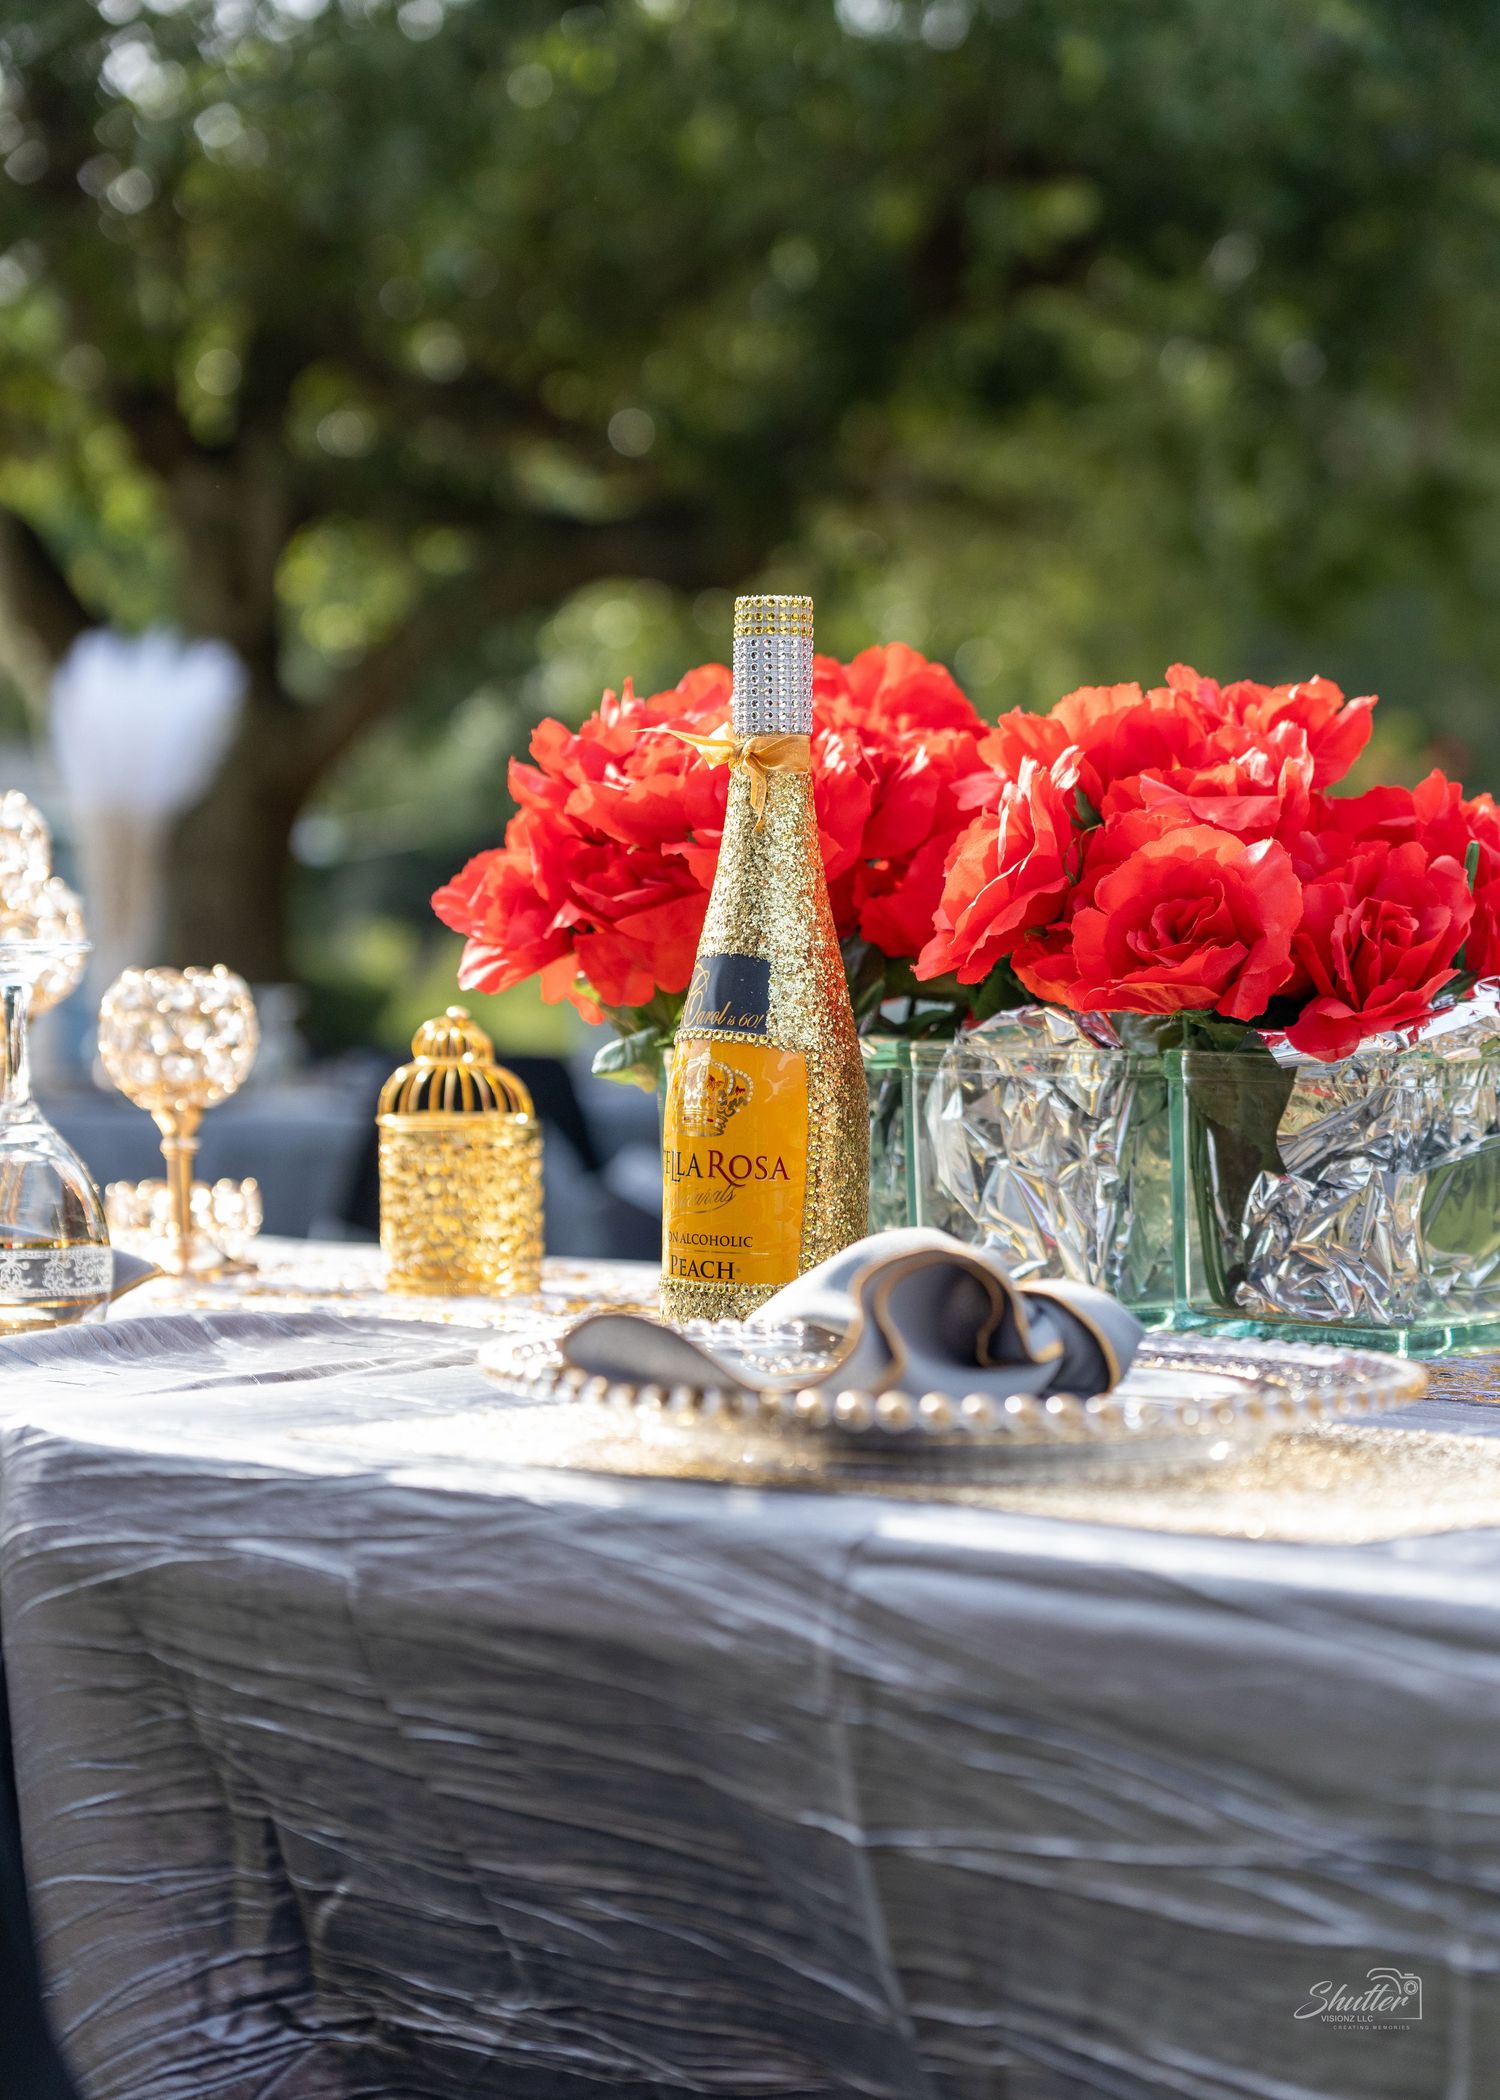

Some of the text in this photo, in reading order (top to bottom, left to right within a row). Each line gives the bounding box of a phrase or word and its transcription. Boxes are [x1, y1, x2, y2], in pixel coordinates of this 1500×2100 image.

[683, 963, 765, 1029] Carol is 60!
[707, 1149, 791, 1188] ROSA
[680, 1233, 753, 1248] ALCOHOLIC
[670, 1254, 735, 1280] PEACH
